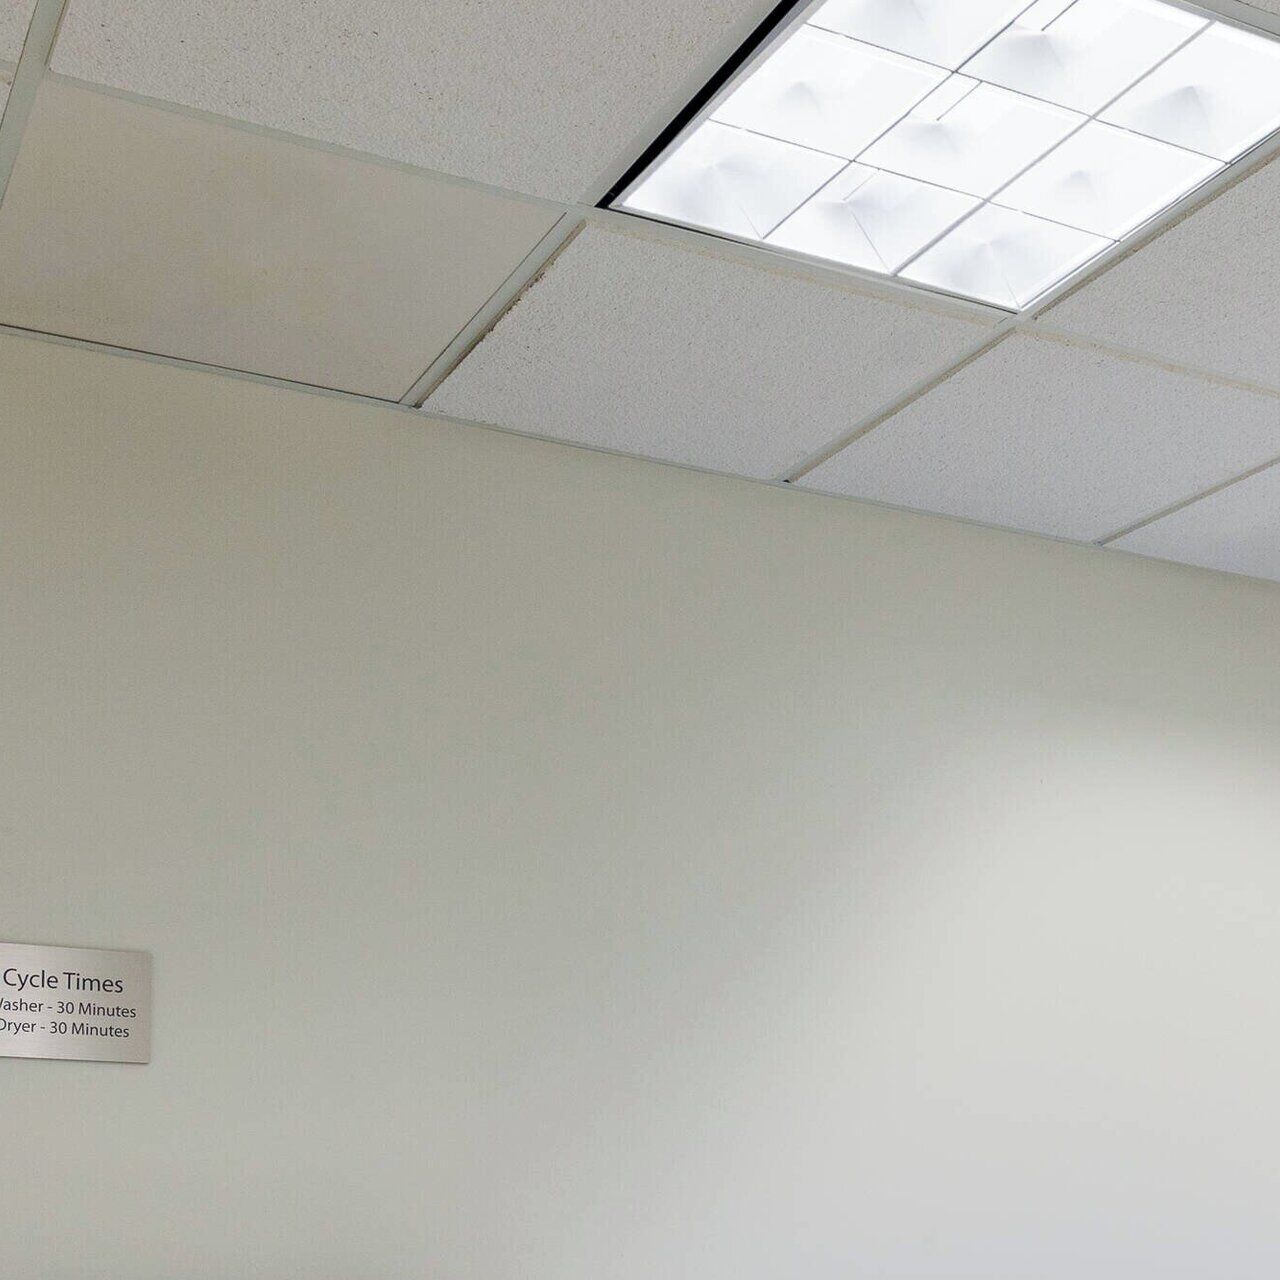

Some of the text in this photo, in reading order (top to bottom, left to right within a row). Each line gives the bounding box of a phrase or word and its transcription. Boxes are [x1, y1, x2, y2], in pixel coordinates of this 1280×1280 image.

[3, 968, 123, 993] Cycle Times
[57, 1002, 74, 1014] 30
[79, 1002, 136, 1018] Minutes
[50, 1022, 66, 1034] 30
[72, 1022, 129, 1037] Minutes
